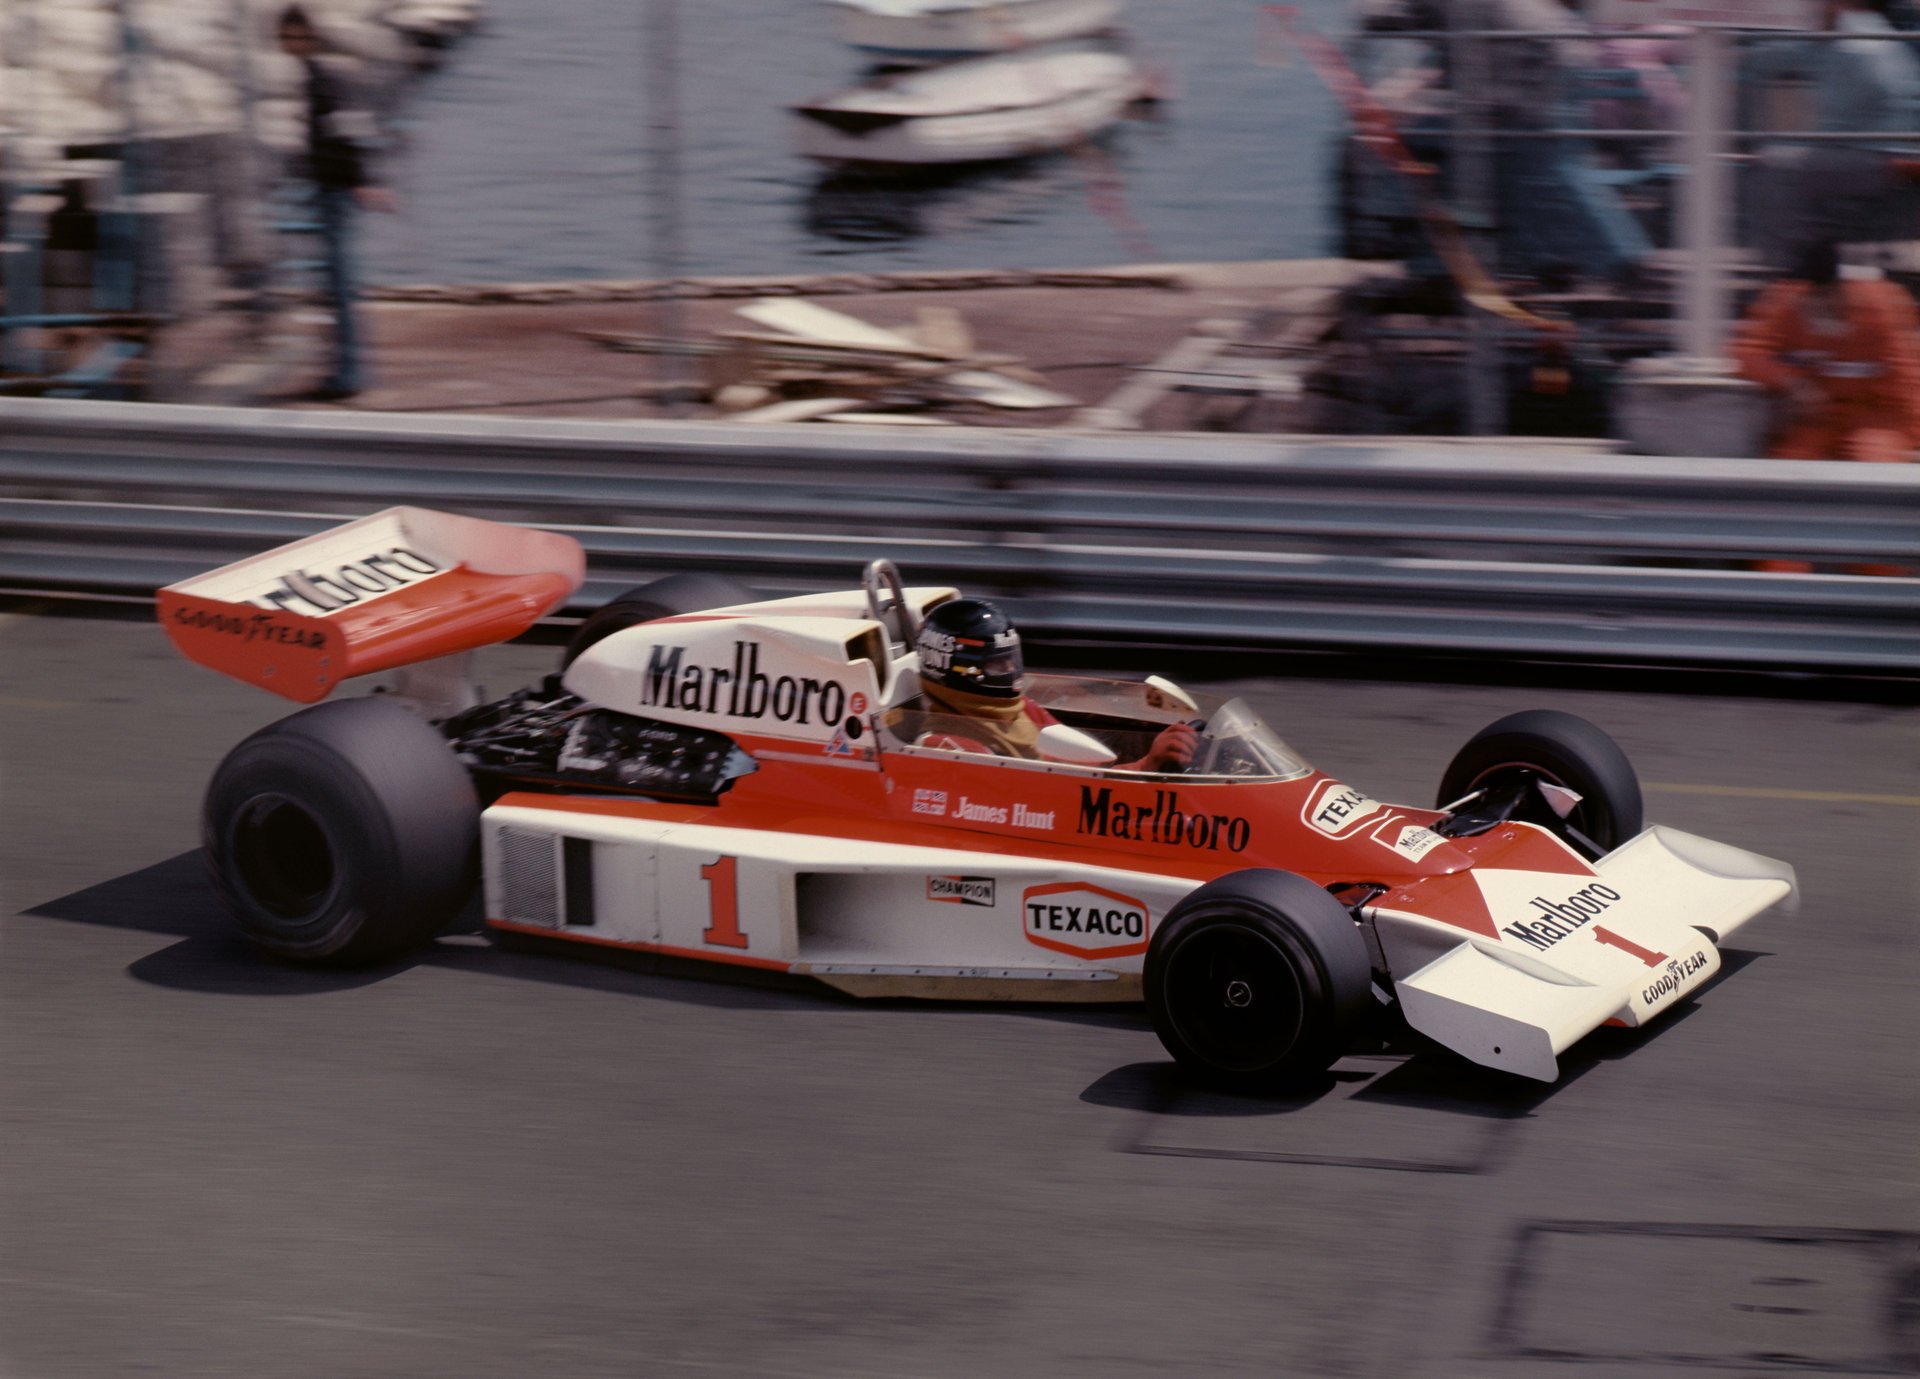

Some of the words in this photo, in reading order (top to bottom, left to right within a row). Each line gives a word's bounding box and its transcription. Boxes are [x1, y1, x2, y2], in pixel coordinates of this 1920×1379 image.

[255, 548, 437, 612] rlboro
[174, 606, 328, 649] GOODYEAR
[640, 640, 846, 727] Marlboro
[951, 796, 1008, 824] James
[1010, 803, 1056, 830] Hunt
[1075, 785, 1251, 853] Marlboro
[1317, 790, 1367, 826] TEXA
[701, 855, 748, 949] 1
[931, 879, 991, 898] CHAMPION
[1026, 902, 1143, 938] TEXACO
[1502, 882, 1622, 952] Marlboro
[1592, 924, 1669, 968] 1
[1642, 951, 1708, 1005] GOODYEAR
